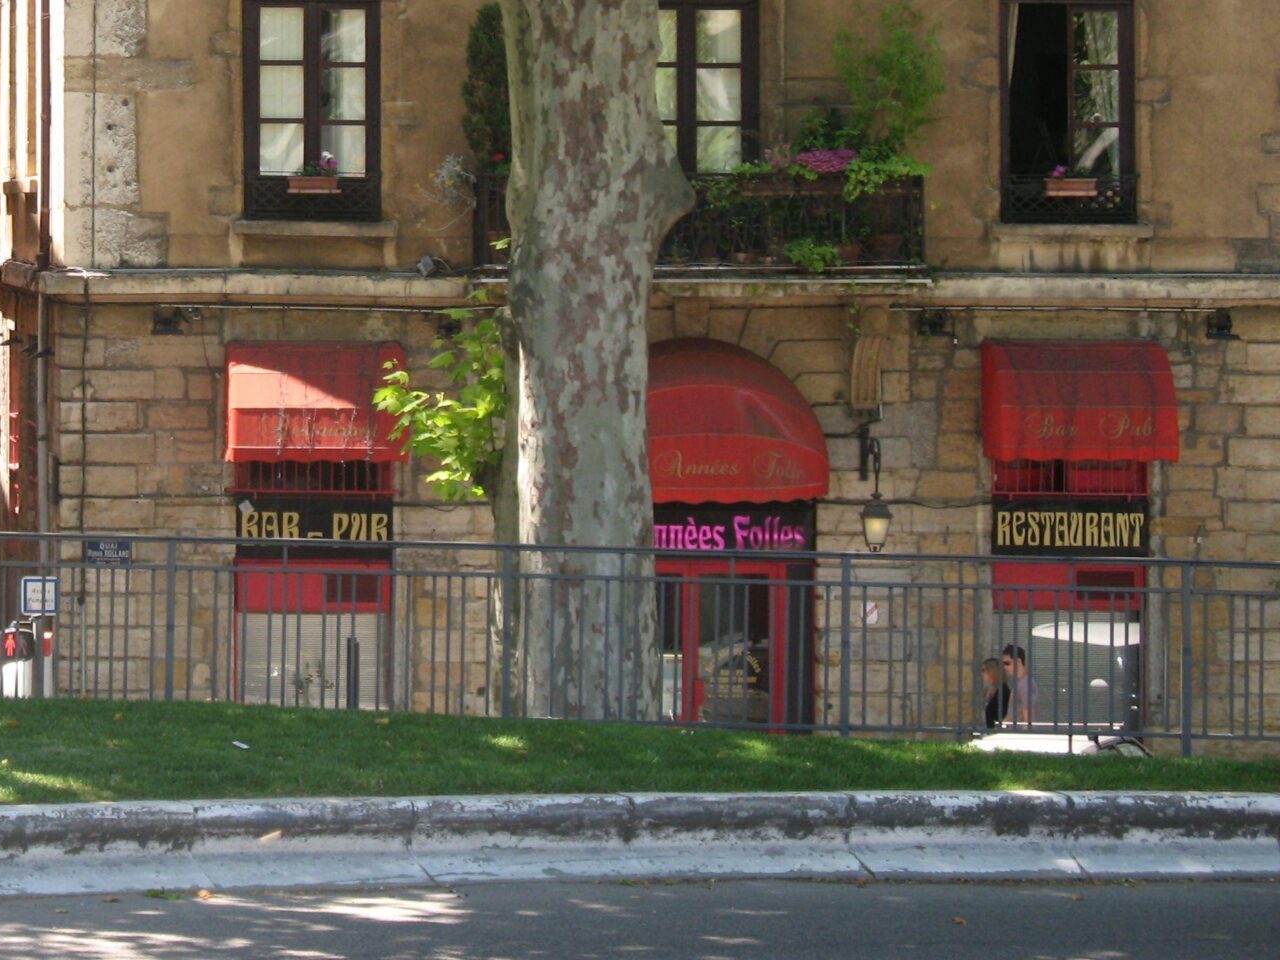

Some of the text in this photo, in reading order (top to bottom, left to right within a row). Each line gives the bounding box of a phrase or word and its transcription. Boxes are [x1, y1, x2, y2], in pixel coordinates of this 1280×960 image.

[1024, 412, 1153, 440] Bar Pub
[241, 511, 300, 542] BAR
[332, 513, 388, 543] PUB
[733, 515, 805, 551] Folles
[997, 511, 1144, 548] RESTAURANT
